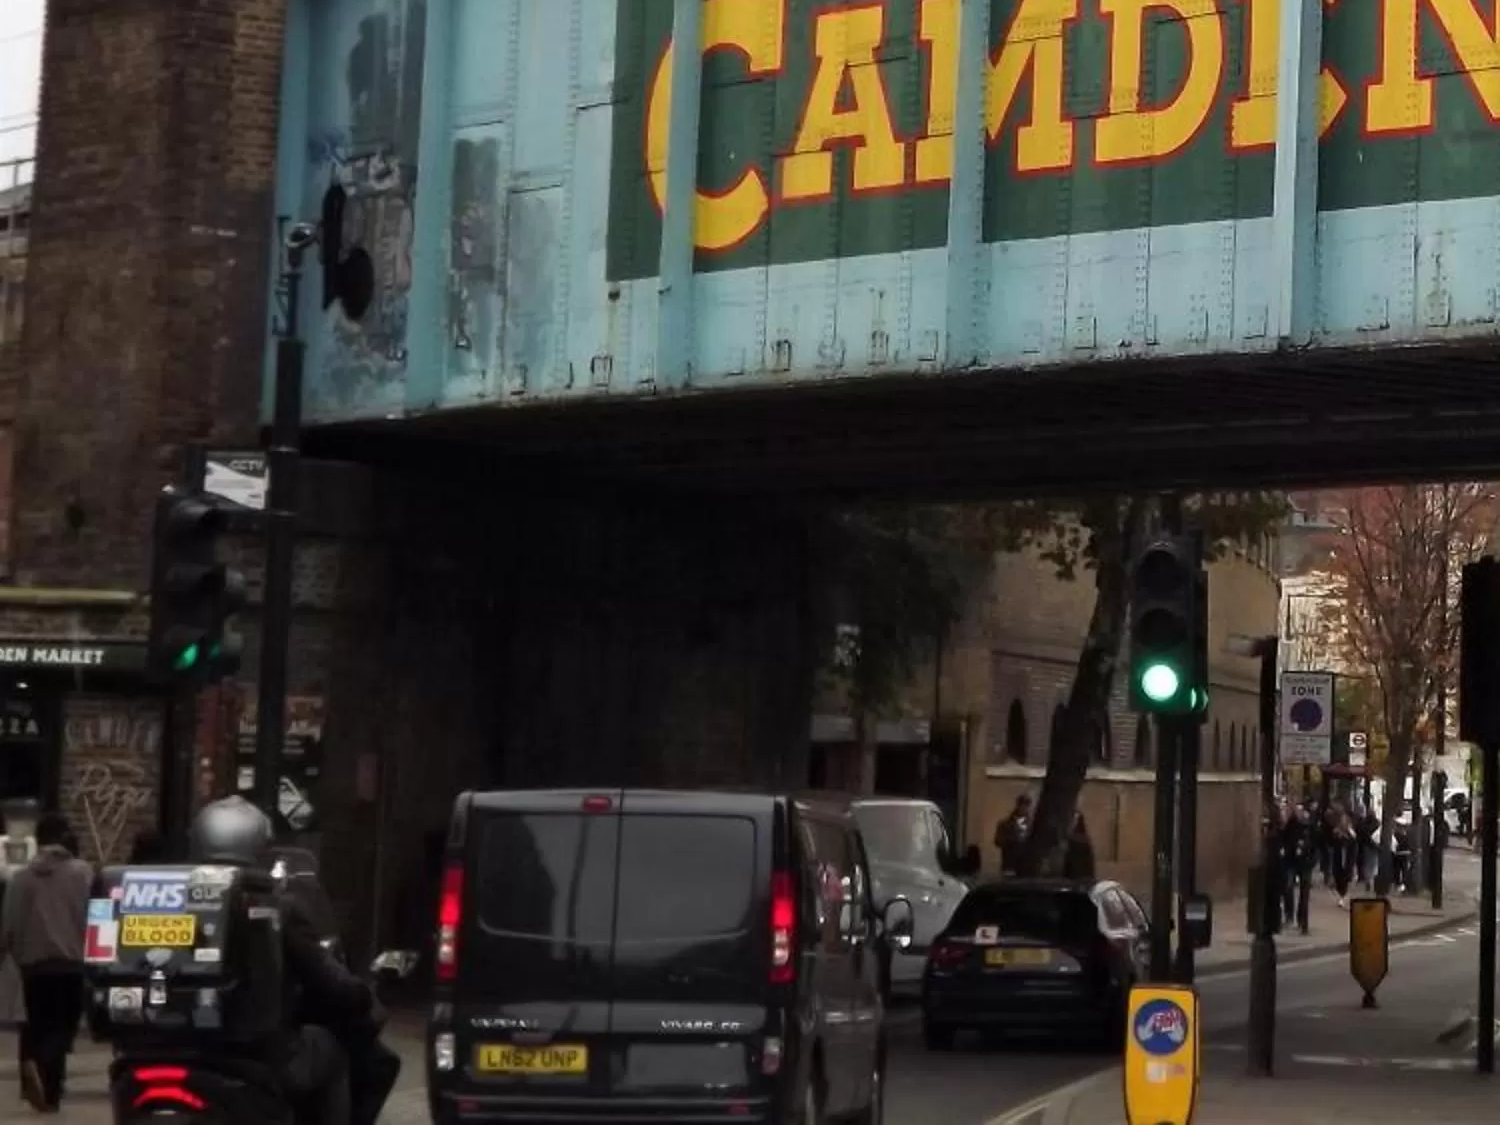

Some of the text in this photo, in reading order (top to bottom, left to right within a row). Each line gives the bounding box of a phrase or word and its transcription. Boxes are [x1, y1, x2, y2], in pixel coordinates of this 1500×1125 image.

[32, 647, 105, 665] MARKET
[124, 882, 186, 908] NHS
[125, 929, 192, 942] BLOOD
